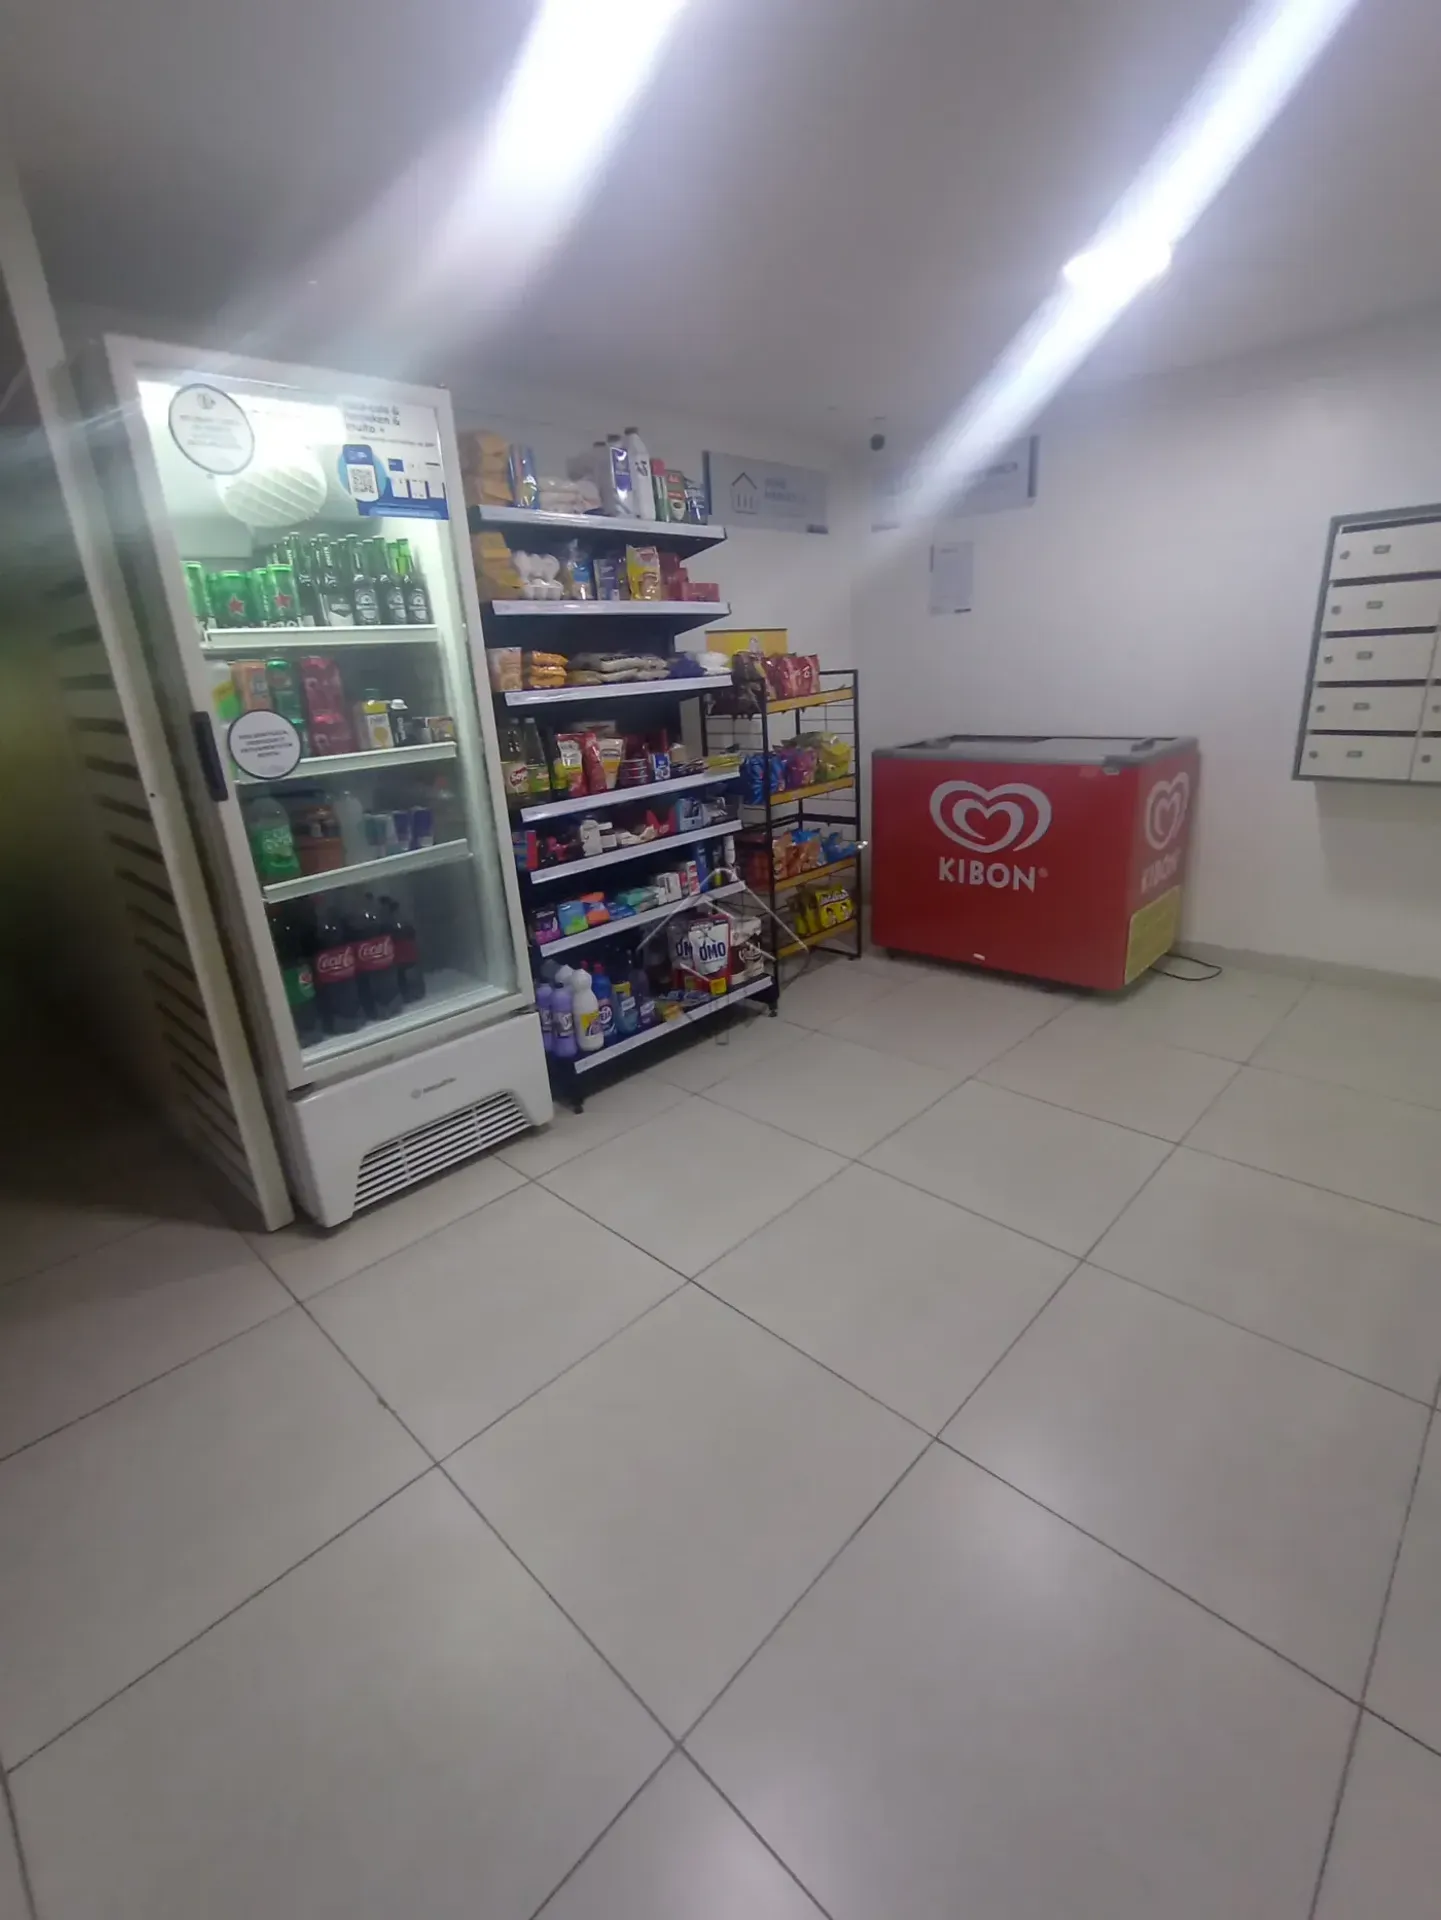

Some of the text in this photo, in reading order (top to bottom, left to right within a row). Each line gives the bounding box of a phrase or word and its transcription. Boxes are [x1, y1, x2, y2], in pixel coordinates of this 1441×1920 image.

[938, 856, 1036, 893] KIBON
[675, 939, 693, 957] OM
[700, 941, 726, 961] OMO
